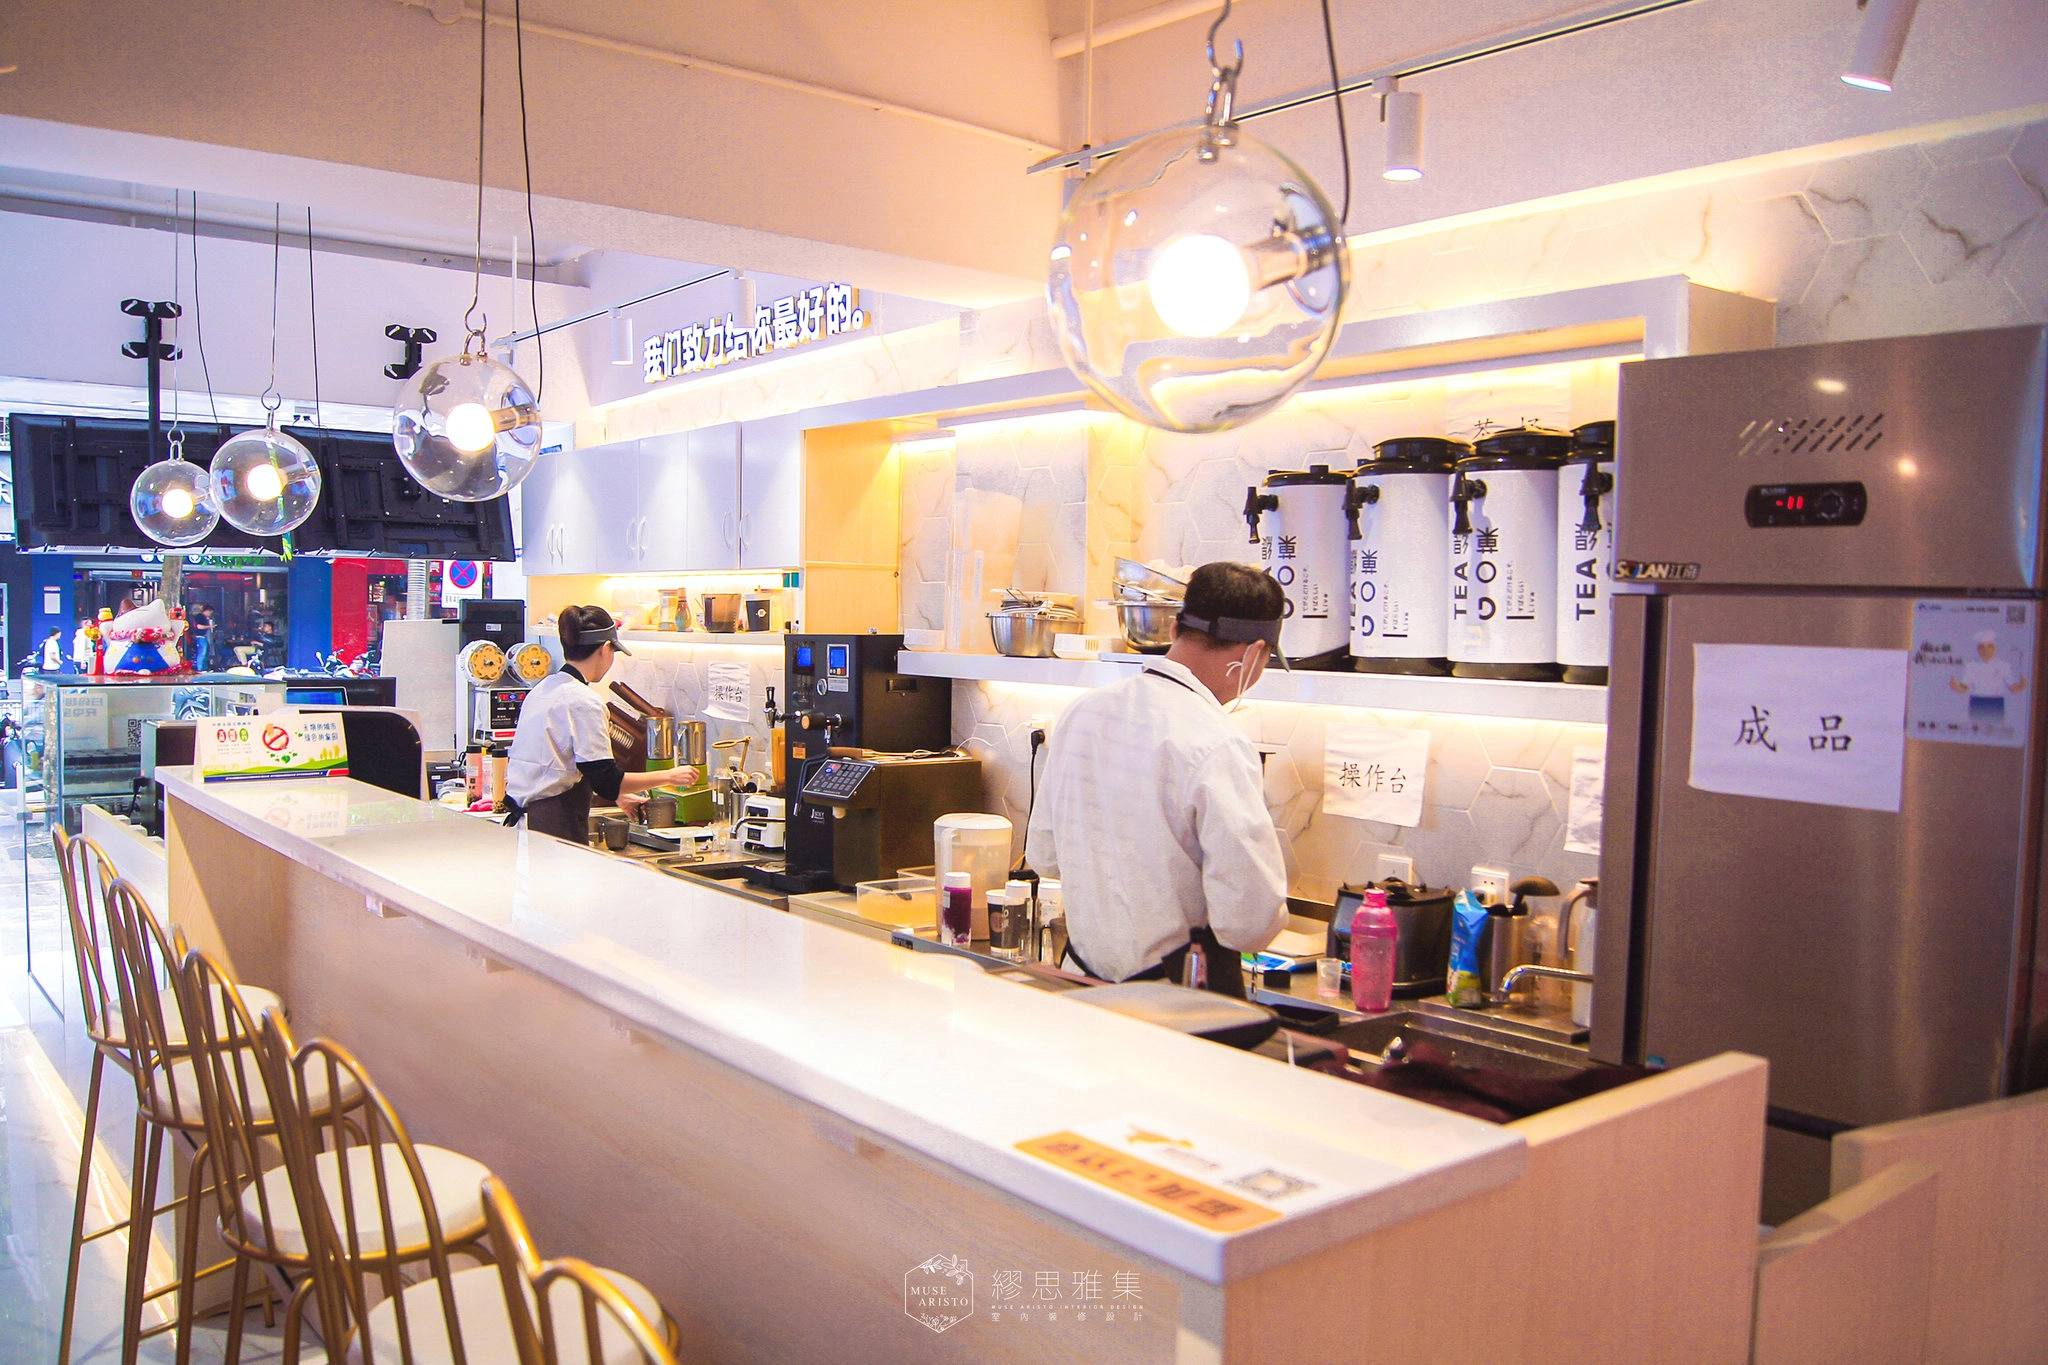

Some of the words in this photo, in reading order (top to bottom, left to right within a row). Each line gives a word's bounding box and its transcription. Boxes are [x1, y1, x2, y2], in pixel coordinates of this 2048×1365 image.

[1734, 705, 1852, 752] 成品
[1339, 762, 1407, 794] 操作台
